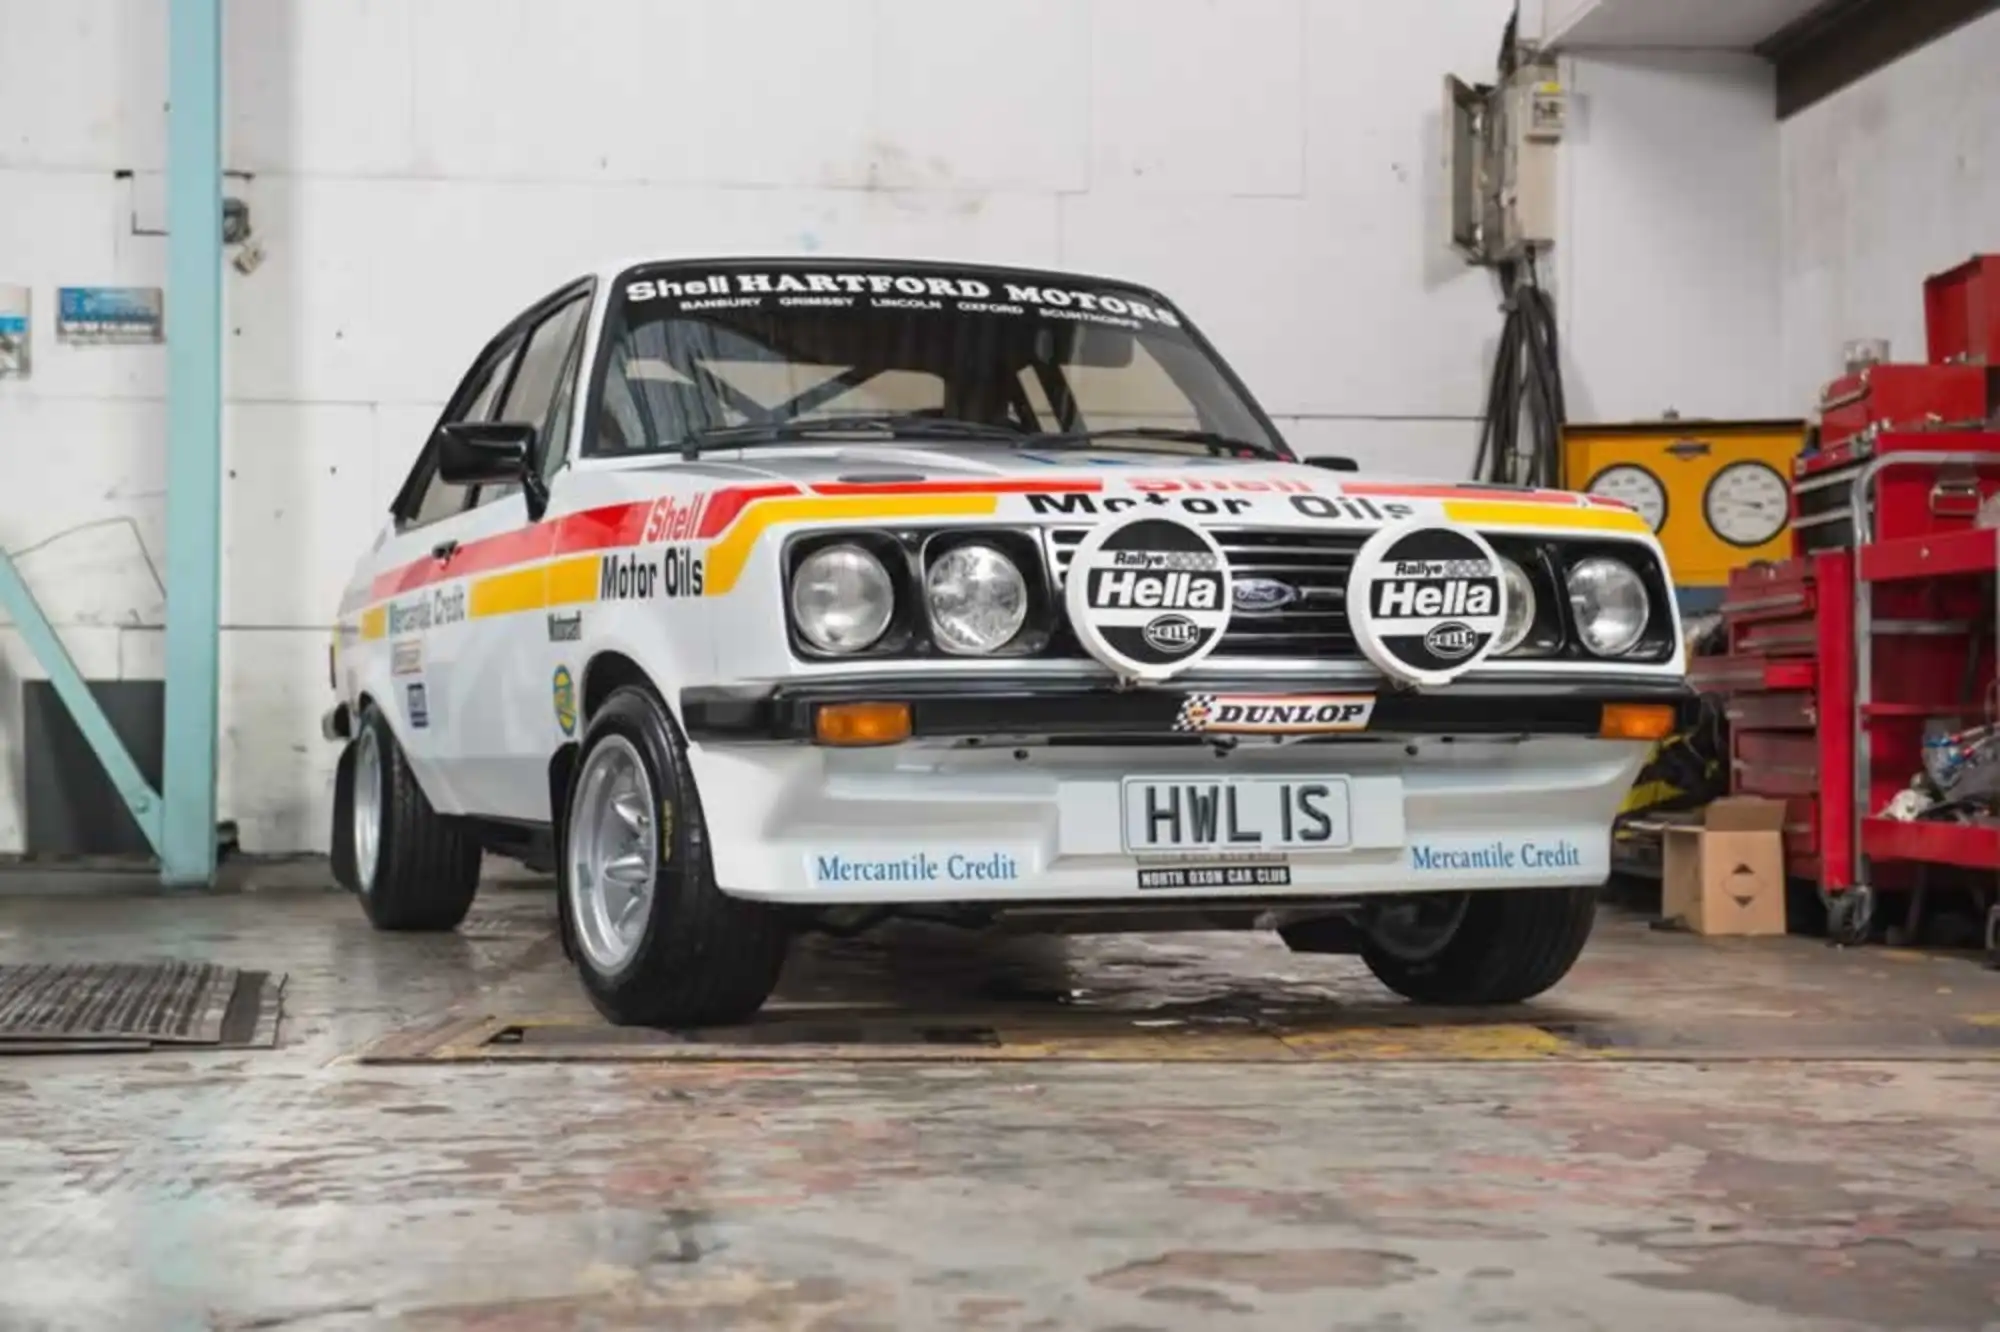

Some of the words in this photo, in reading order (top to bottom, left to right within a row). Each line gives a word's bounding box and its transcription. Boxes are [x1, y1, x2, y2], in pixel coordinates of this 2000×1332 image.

[626, 274, 730, 302] Shell
[736, 273, 990, 299] HARTFORD
[1003, 283, 1180, 327] MOTORS
[680, 297, 762, 311] BANBURY
[779, 296, 854, 307] GRIMSBY
[870, 297, 942, 309] LINCOLN
[957, 301, 1024, 314] OXFORD
[1125, 476, 1314, 492] Shell
[646, 493, 705, 543] Shell
[601, 551, 657, 601] Motor
[665, 546, 703, 598] Oils
[1114, 551, 1164, 569] Rallye
[1395, 560, 1443, 576] Rallye
[1096, 571, 1217, 608] Hella
[1379, 580, 1492, 616] Hella
[1215, 704, 1364, 723] DUNLOP
[1146, 785, 1262, 843] HWL
[817, 852, 938, 881] Mercantile
[947, 852, 1018, 880] Credit
[1411, 841, 1515, 869] Mercantile
[1521, 839, 1581, 868] Credit
[1141, 870, 1185, 887] NORTH
[1188, 869, 1223, 885] OXON
[1227, 868, 1253, 883] CAR
[1257, 868, 1288, 883] CLUB
